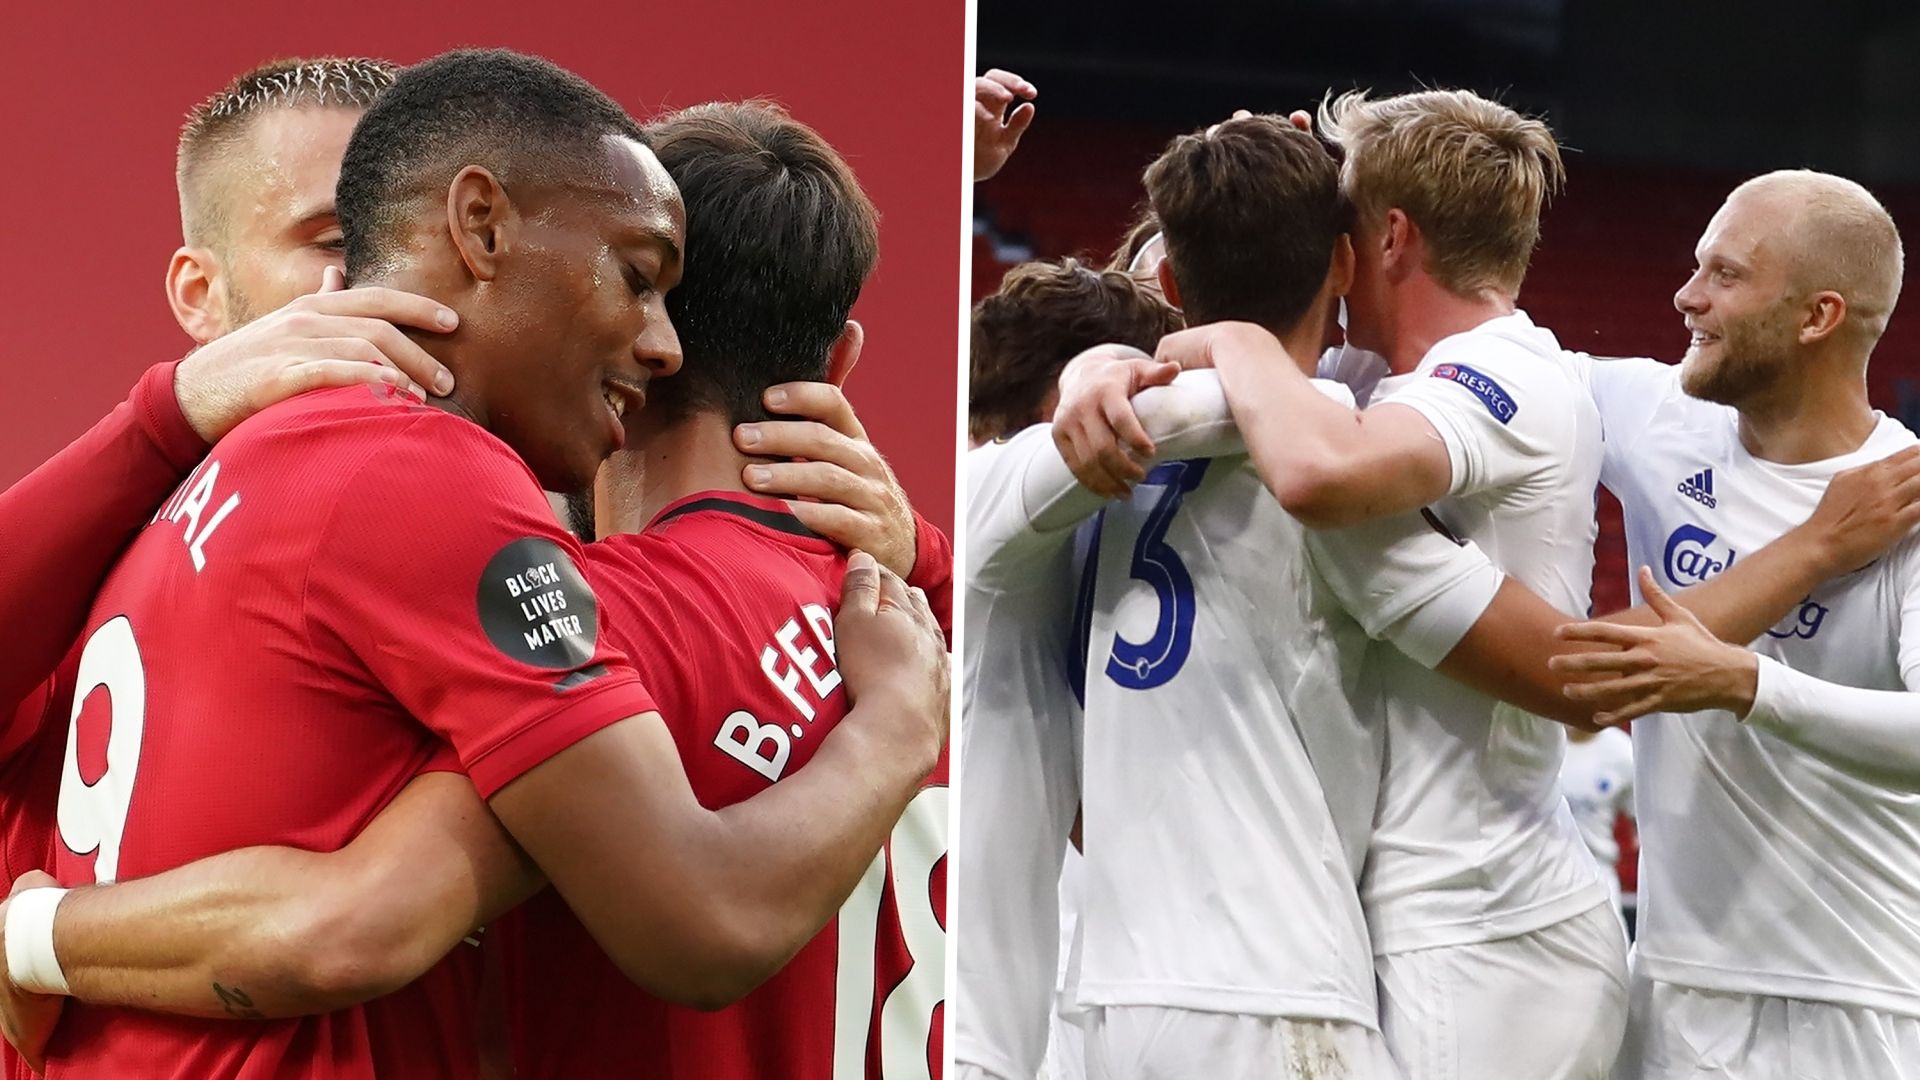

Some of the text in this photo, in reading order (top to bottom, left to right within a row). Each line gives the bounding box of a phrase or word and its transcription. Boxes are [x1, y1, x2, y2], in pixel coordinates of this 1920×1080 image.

[1456, 371, 1514, 420] RESPECT
[1677, 482, 1717, 509] adidas
[505, 562, 560, 597] BLCK
[520, 590, 567, 621] LIVES
[523, 614, 583, 650] MATTER
[56, 614, 147, 885] 9
